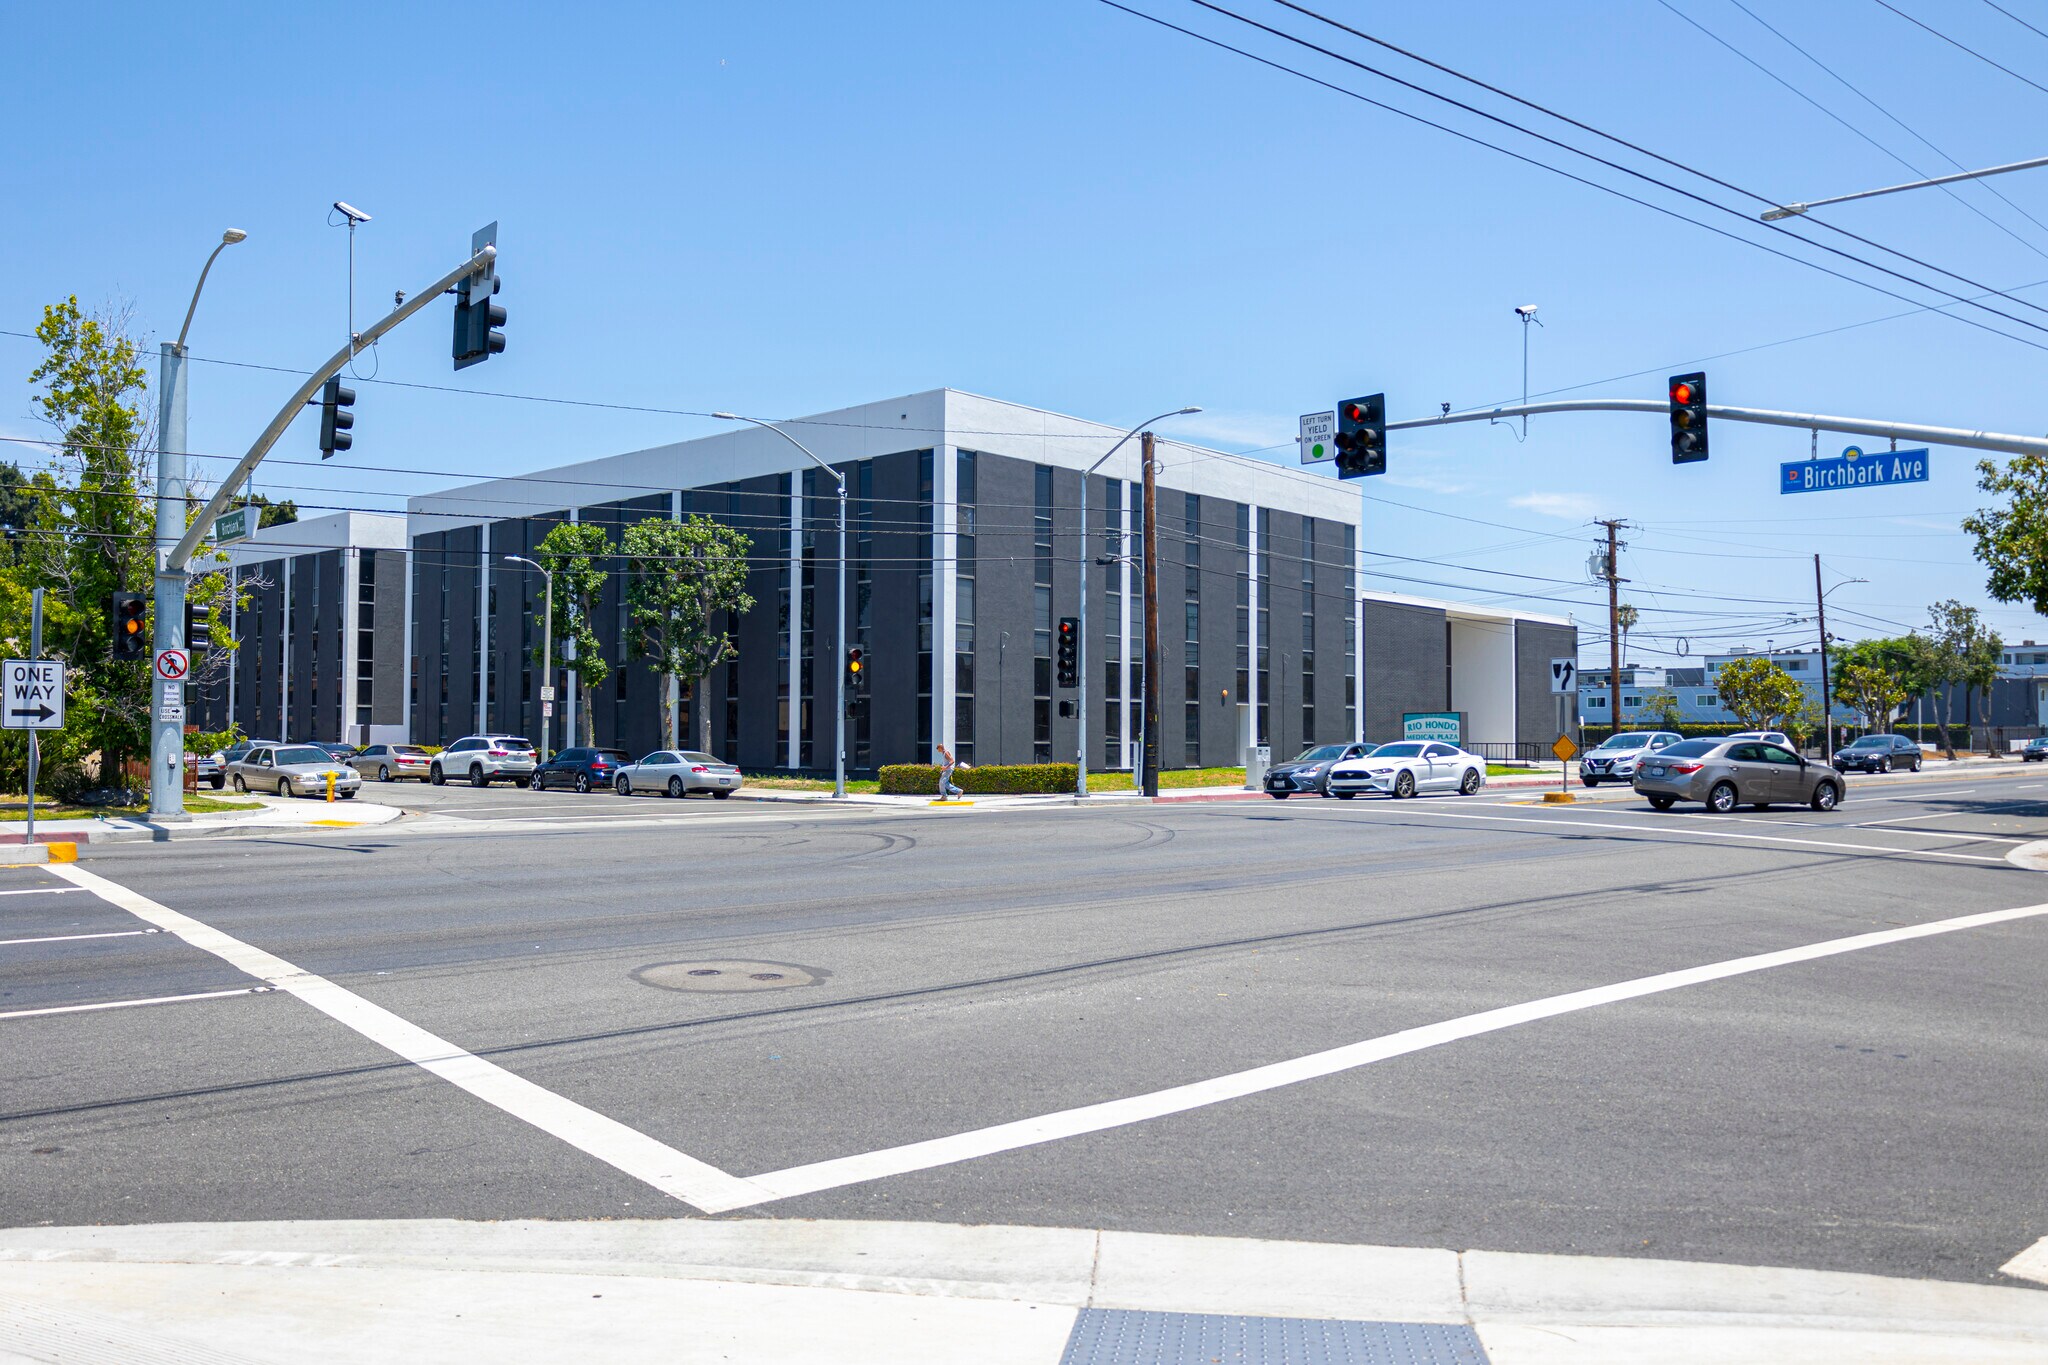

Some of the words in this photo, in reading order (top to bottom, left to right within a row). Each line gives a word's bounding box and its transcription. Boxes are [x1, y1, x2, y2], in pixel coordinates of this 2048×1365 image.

[1308, 424, 1327, 434] YIELD
[1804, 460, 1883, 488] Birchbark
[1892, 458, 1922, 480] Ave
[14, 667, 54, 682] ONE
[14, 685, 56, 700] WAY
[1407, 722, 1422, 731] RIO
[1425, 720, 1457, 731] HONDO
